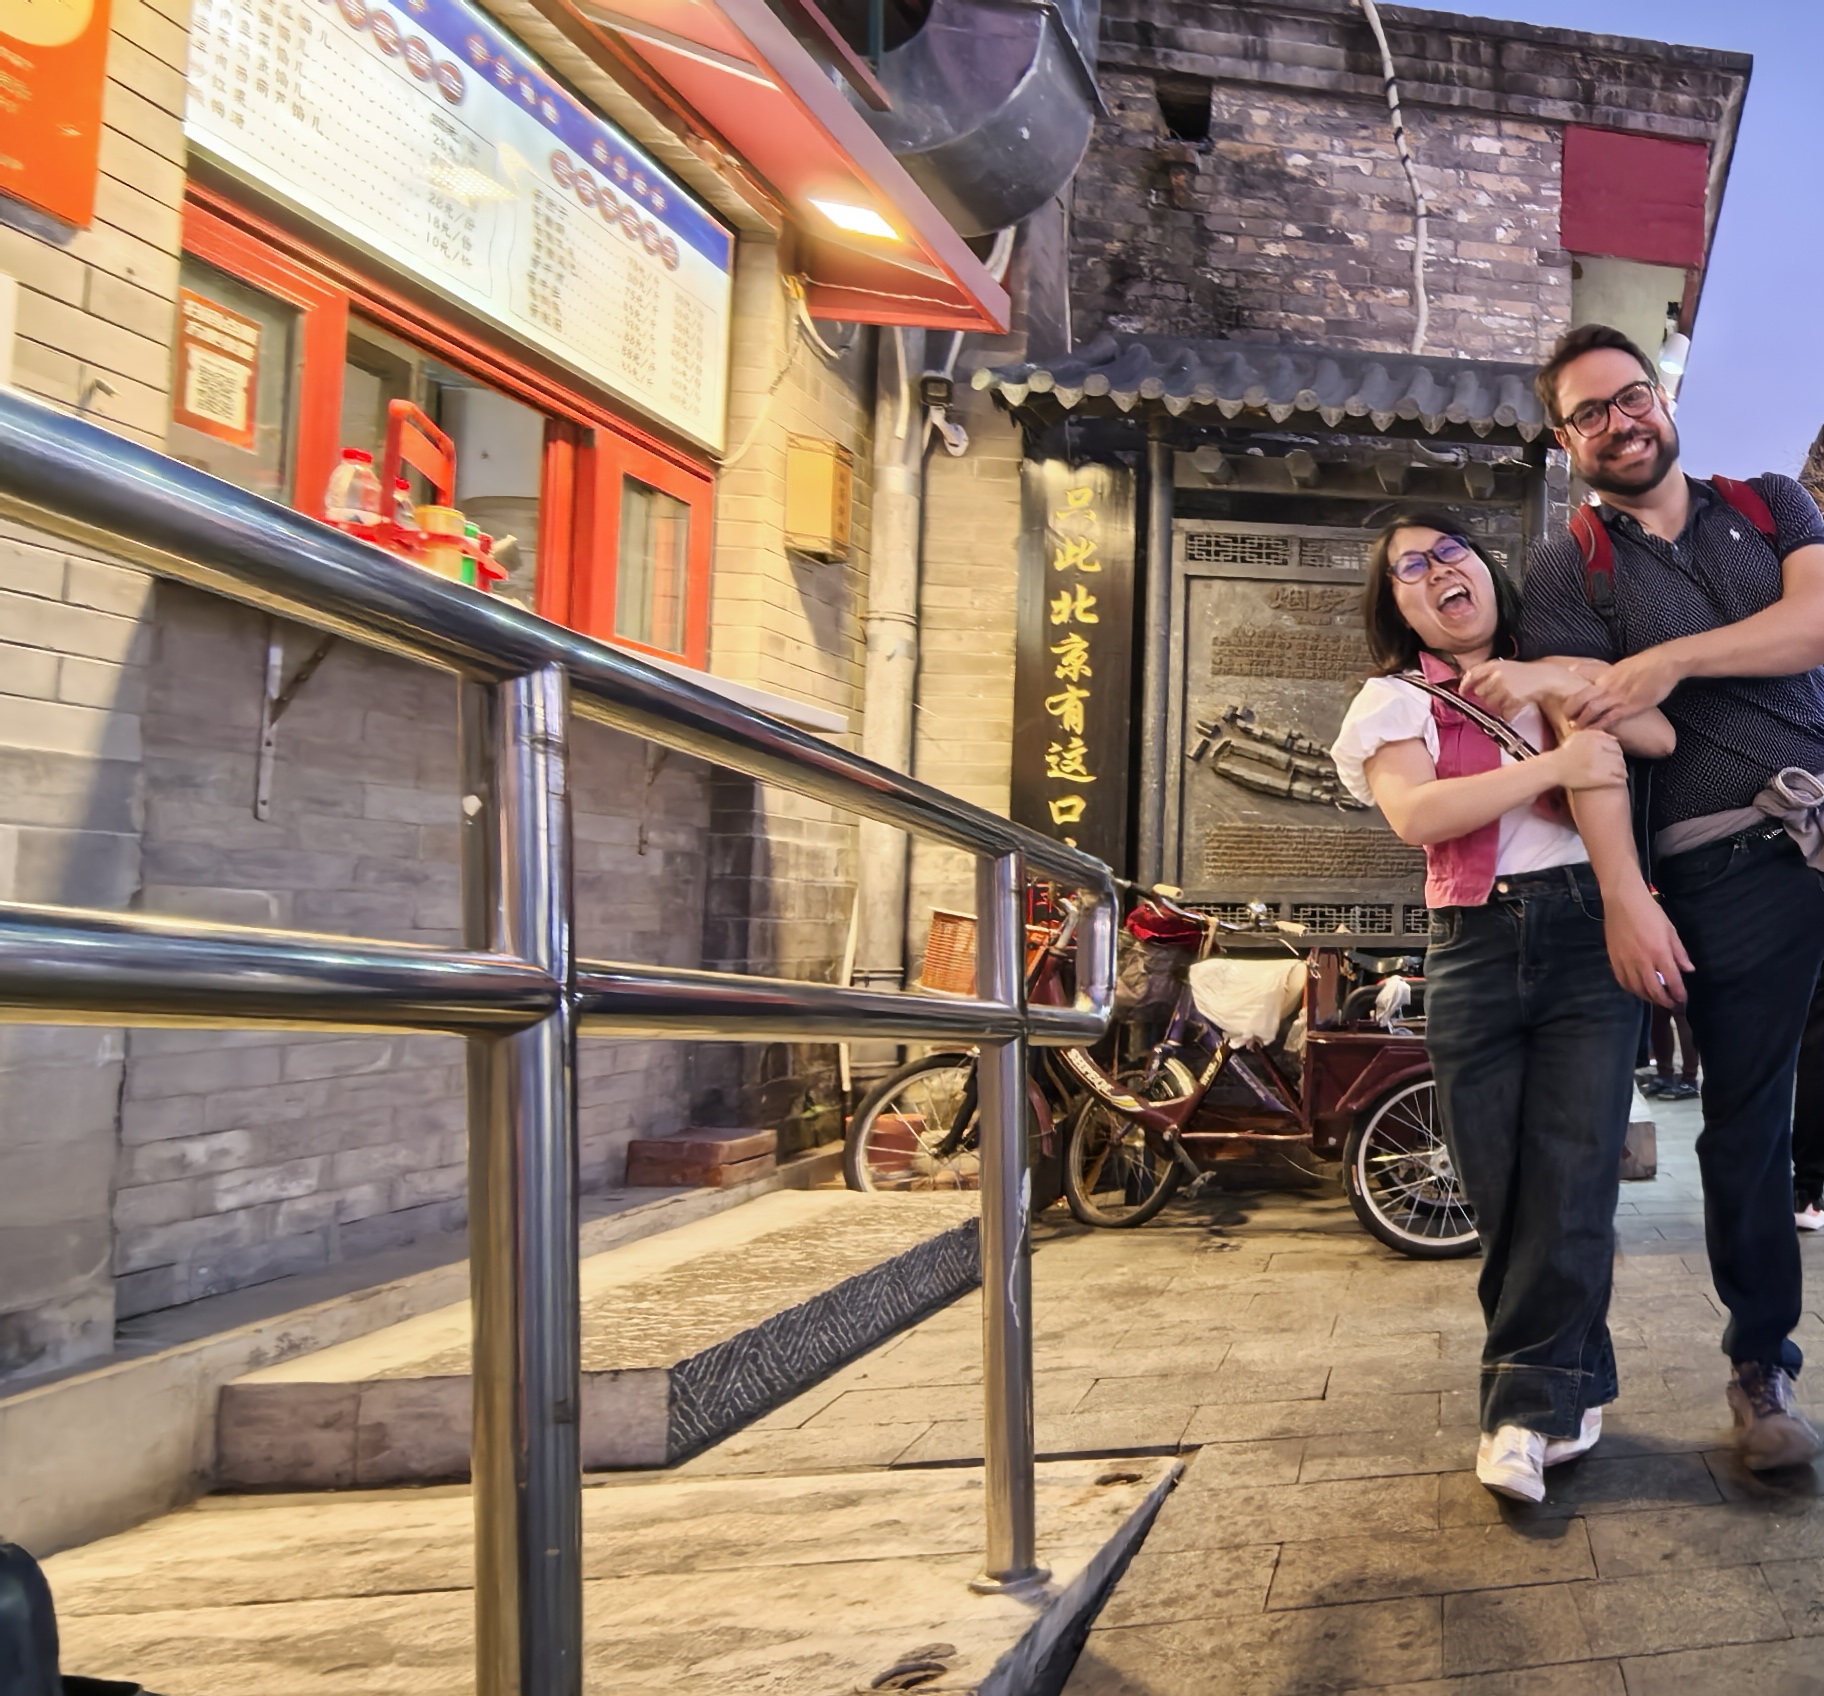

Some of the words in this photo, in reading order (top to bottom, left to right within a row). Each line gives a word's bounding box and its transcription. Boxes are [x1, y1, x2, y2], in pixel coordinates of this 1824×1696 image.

[1044, 487, 1102, 848] 只此北京有这口
